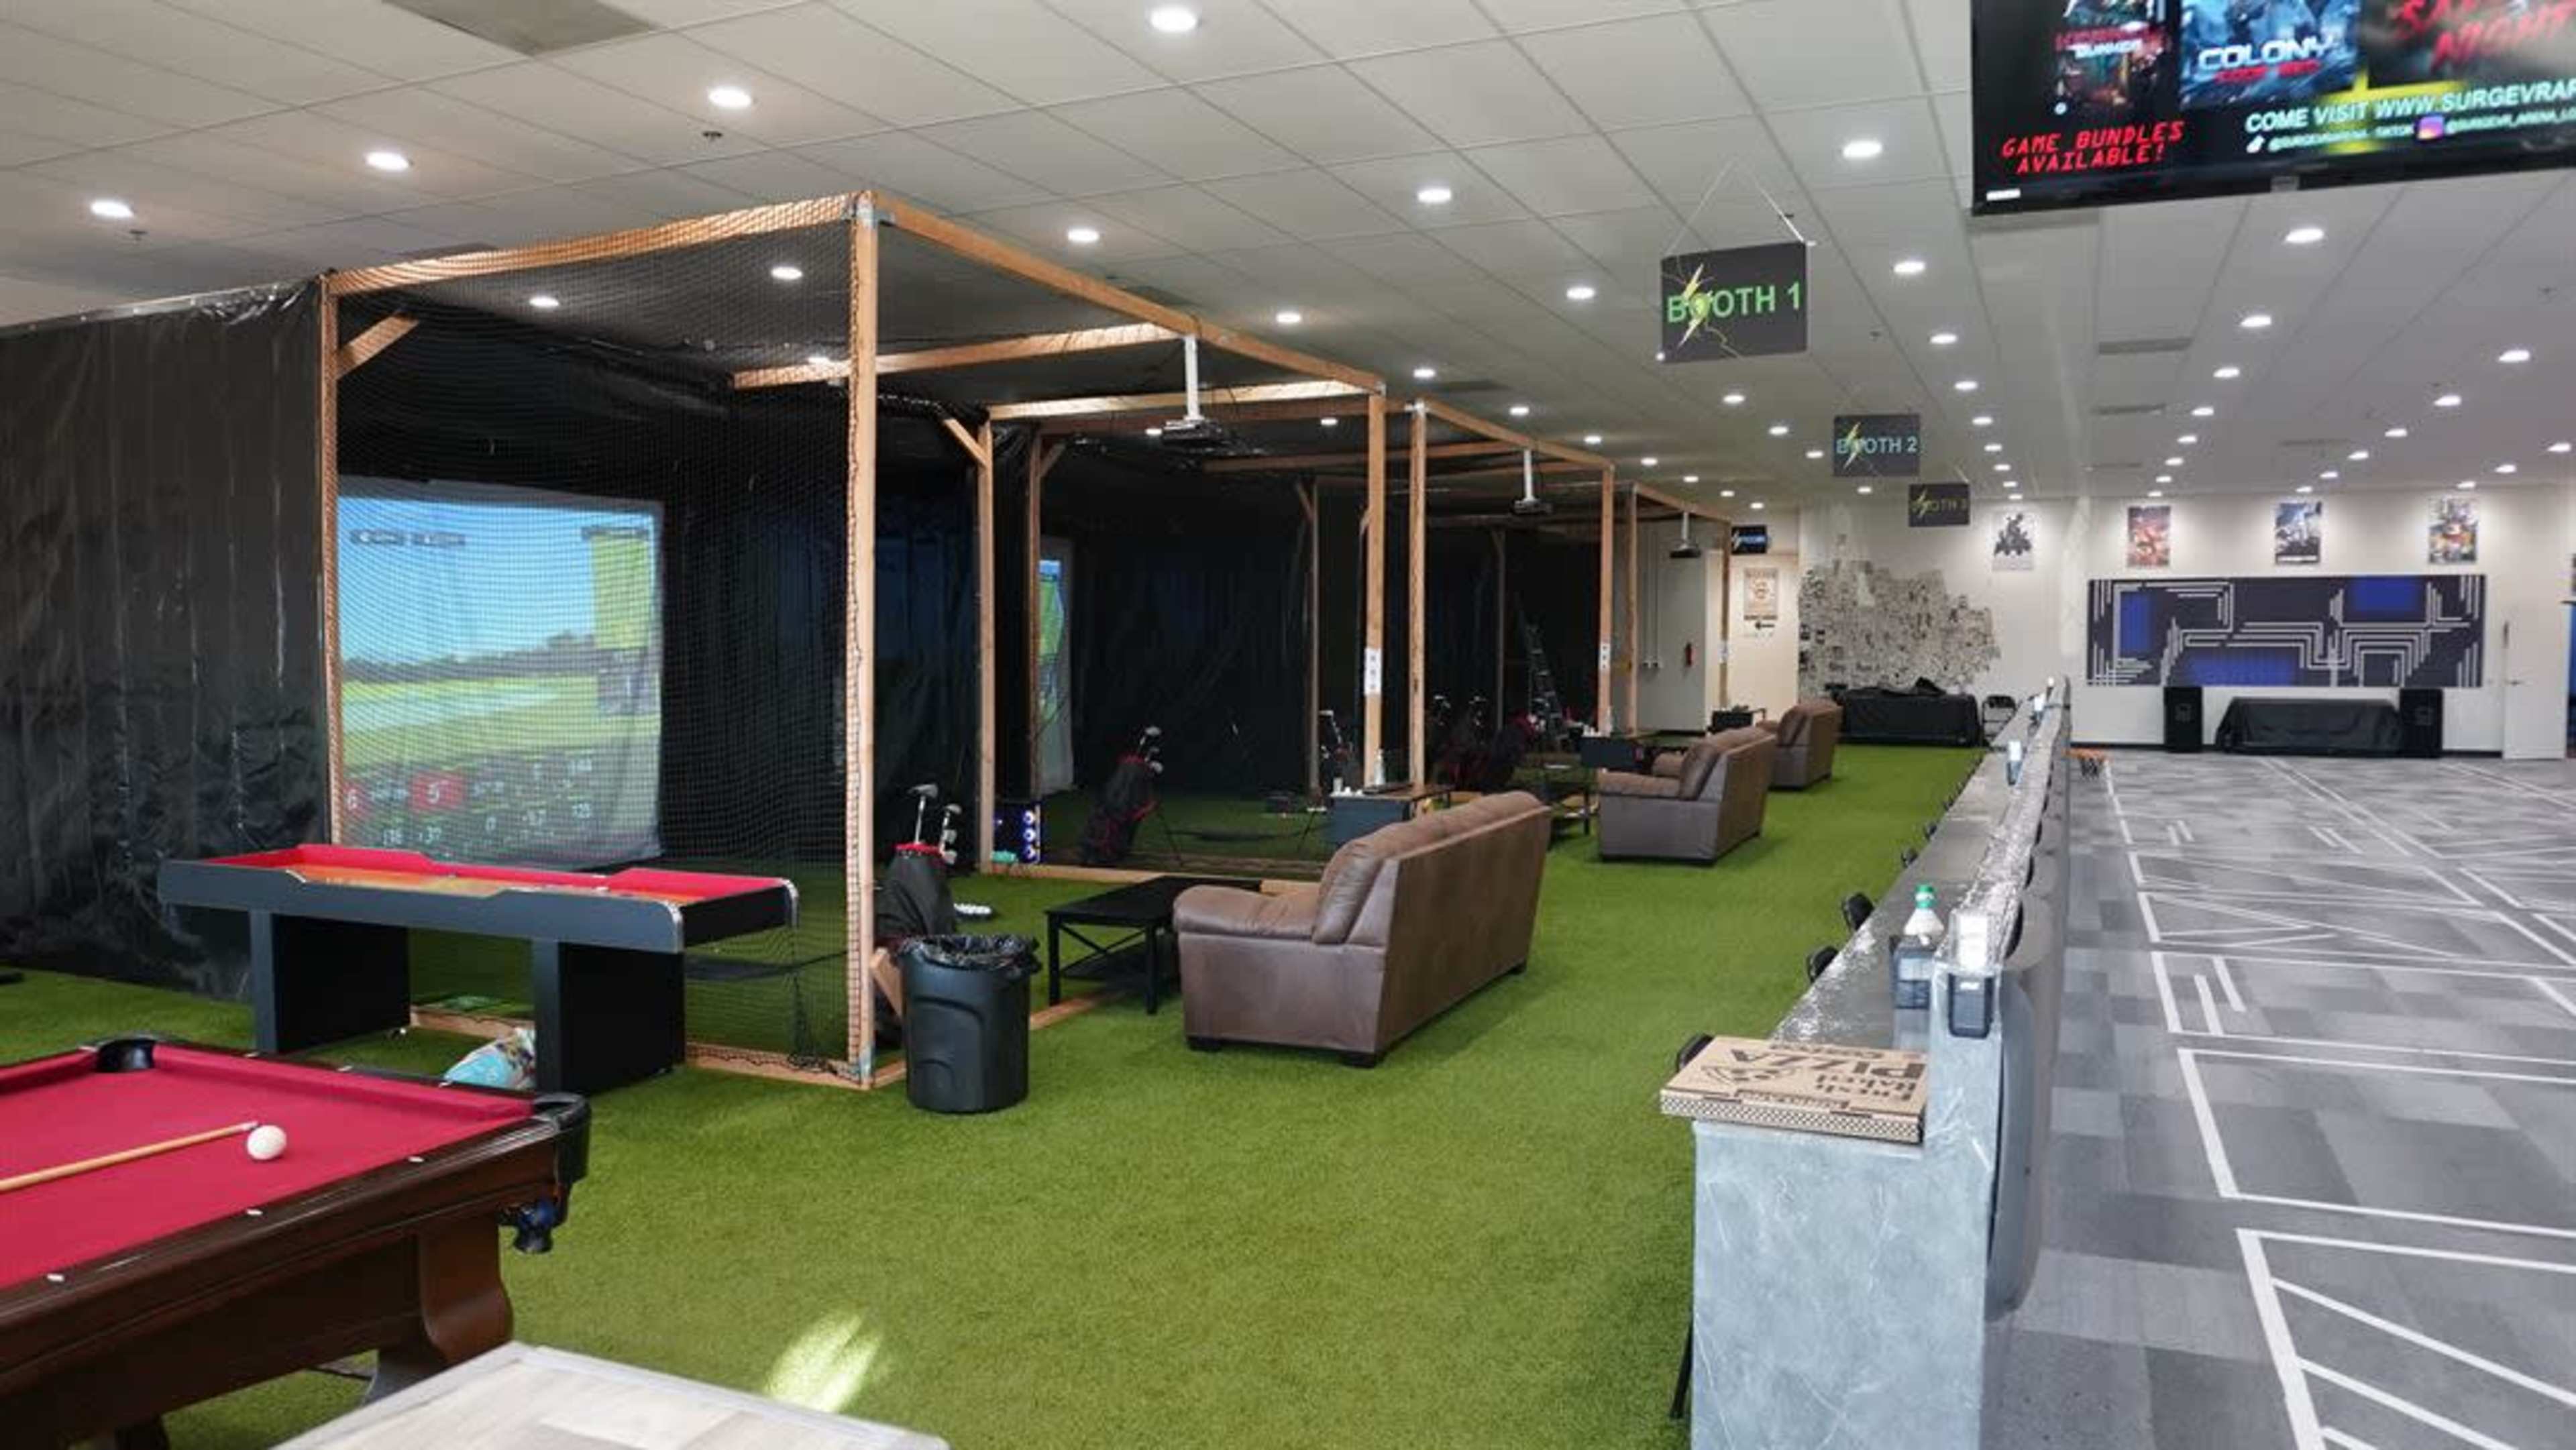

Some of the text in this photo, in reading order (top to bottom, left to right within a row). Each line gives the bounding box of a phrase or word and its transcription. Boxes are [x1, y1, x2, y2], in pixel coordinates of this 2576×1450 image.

[2198, 35, 2334, 70] COLONY
[2245, 108, 2309, 133] COME
[2313, 101, 2369, 125] VISIT
[2002, 121, 2184, 158] GAME BUNDLES
[2016, 143, 2164, 175] AVAILABLE!
[1667, 281, 1800, 323] BOOTH 1
[1907, 435, 1918, 452] 2
[1911, 498, 1956, 513] OTH
[1730, 1048, 1927, 1078] PIZZA
